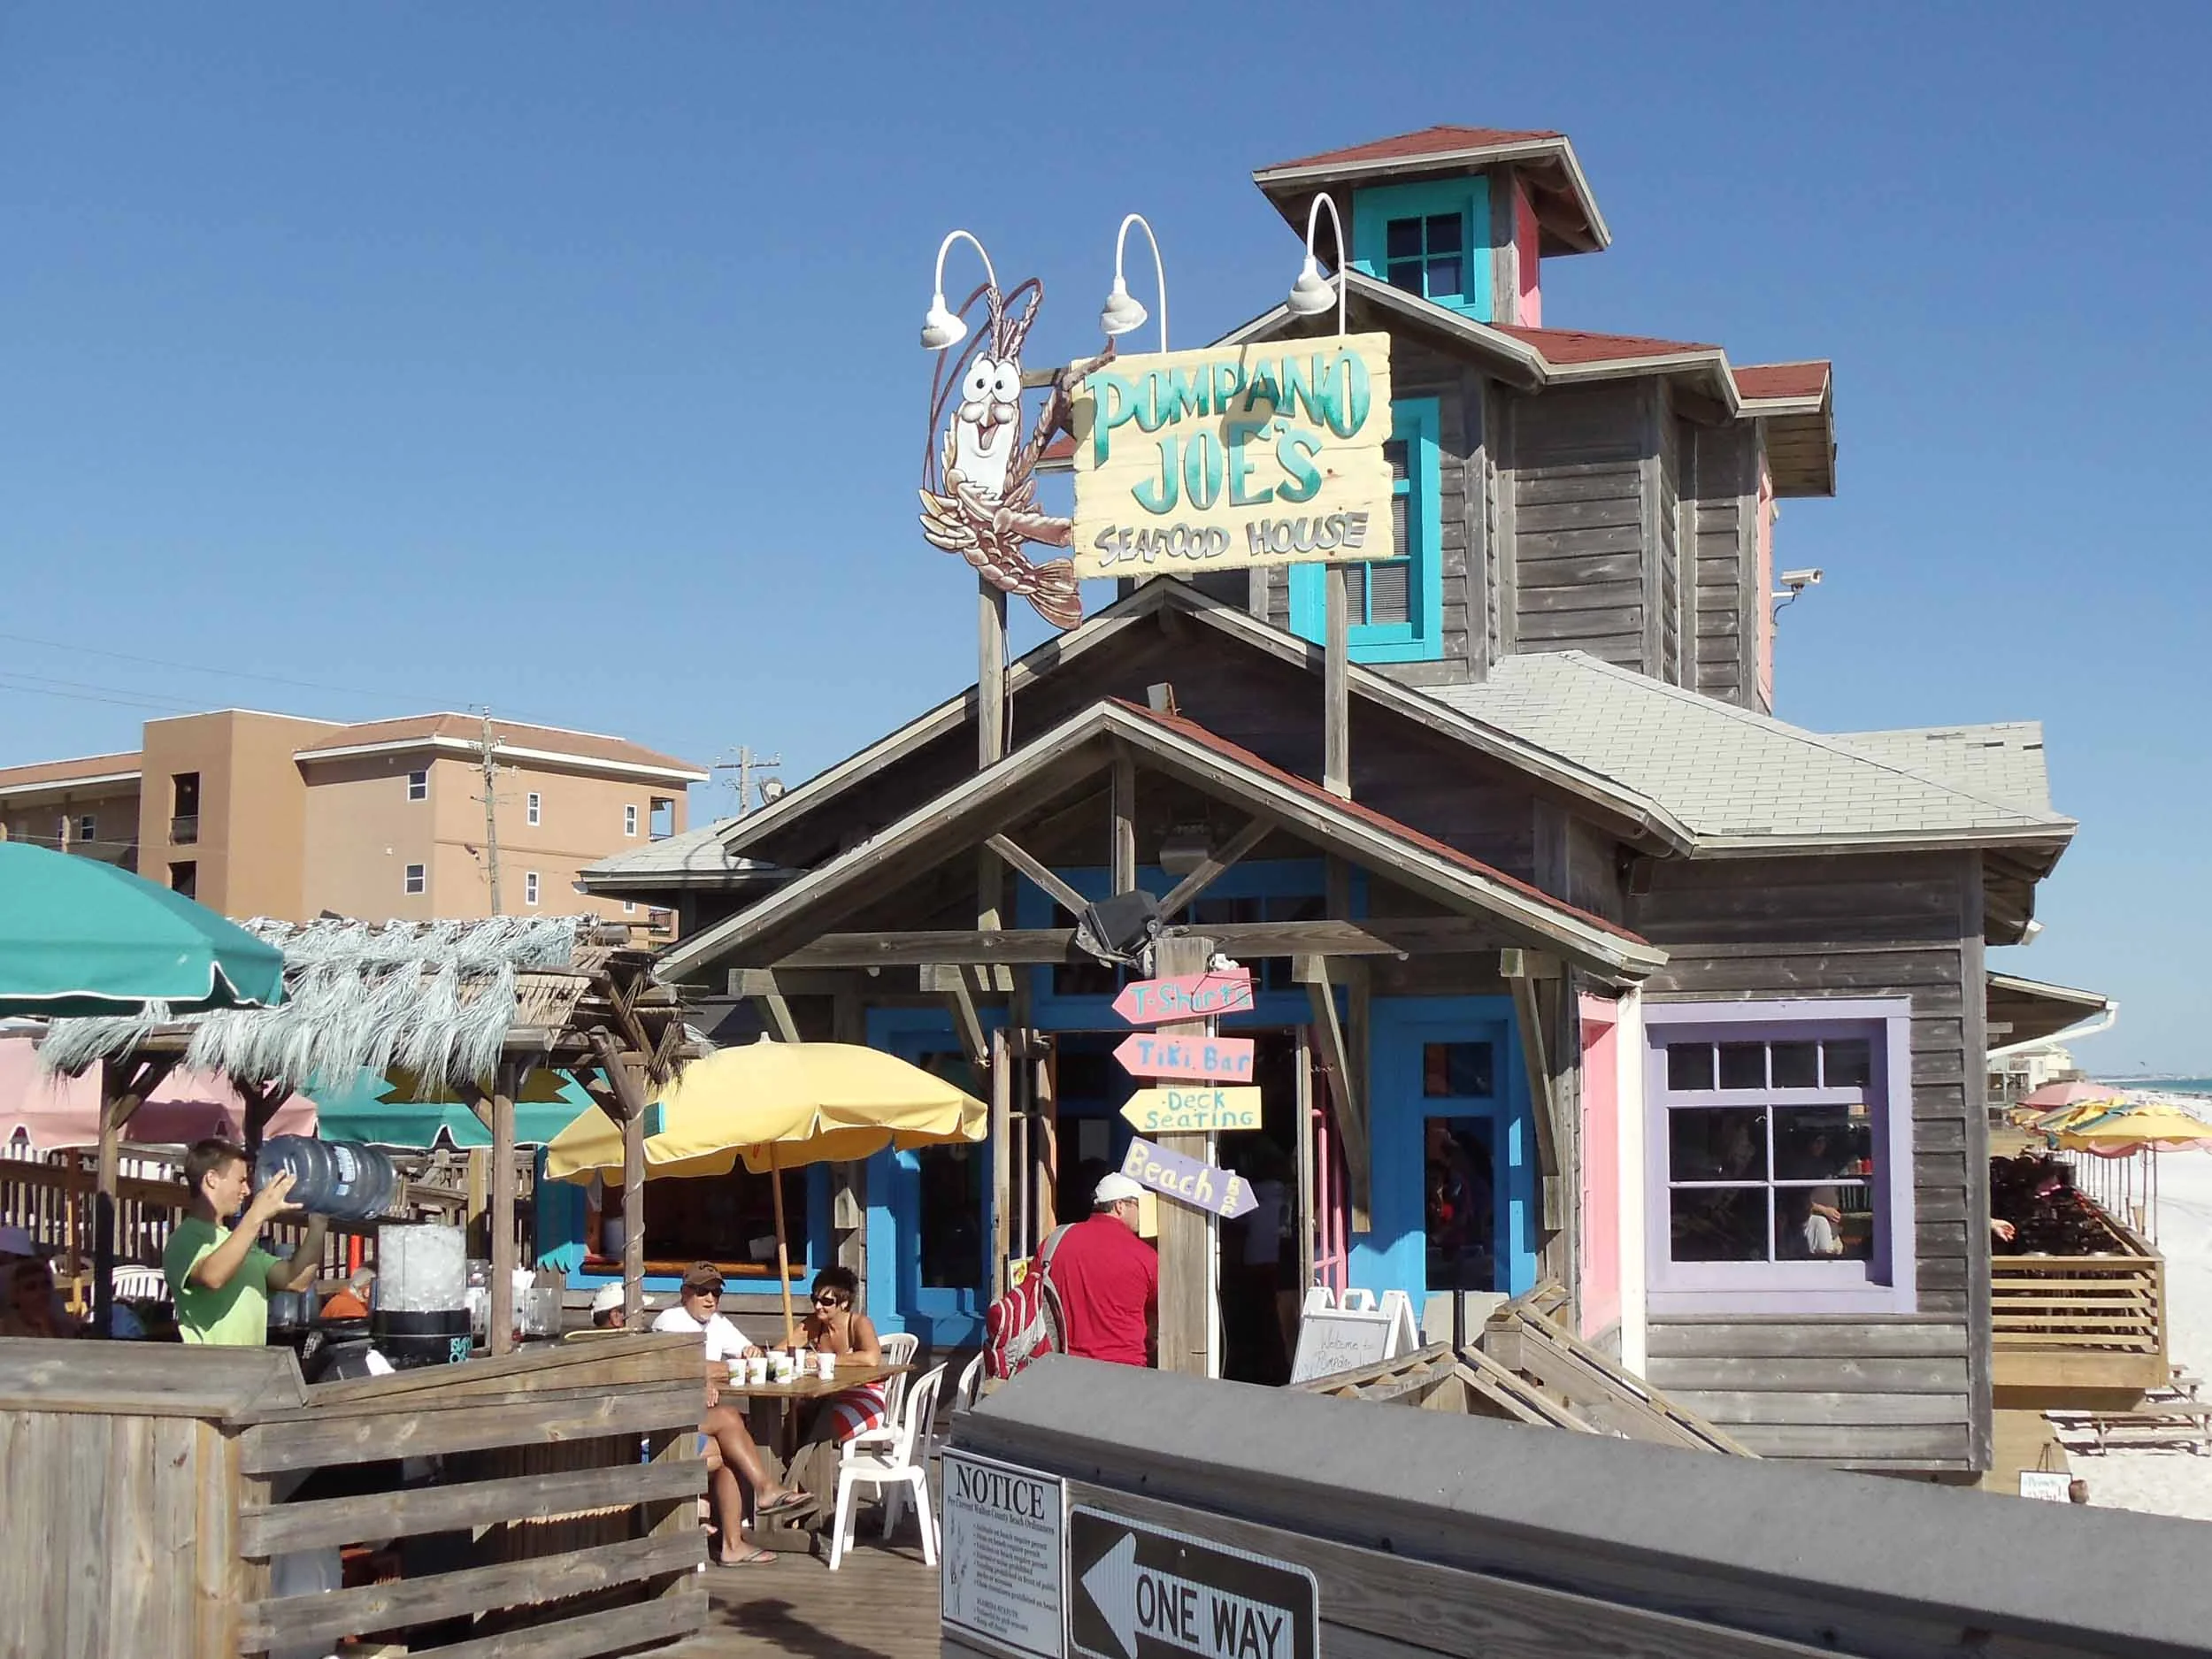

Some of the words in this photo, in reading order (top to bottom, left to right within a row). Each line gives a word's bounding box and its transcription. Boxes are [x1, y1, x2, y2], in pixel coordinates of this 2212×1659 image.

[1083, 345, 1371, 470] POMPANO
[1132, 419, 1322, 515] JOE'S
[1094, 523, 1231, 567] SEAFOOD
[1246, 511, 1368, 555] HOUSE
[1203, 1045, 1249, 1071] Bar
[1125, 1142, 1214, 1203] Beach
[955, 1463, 1045, 1521] NOTICE
[1136, 1573, 1200, 1644] ONE
[1211, 1596, 1283, 1659] WAY
